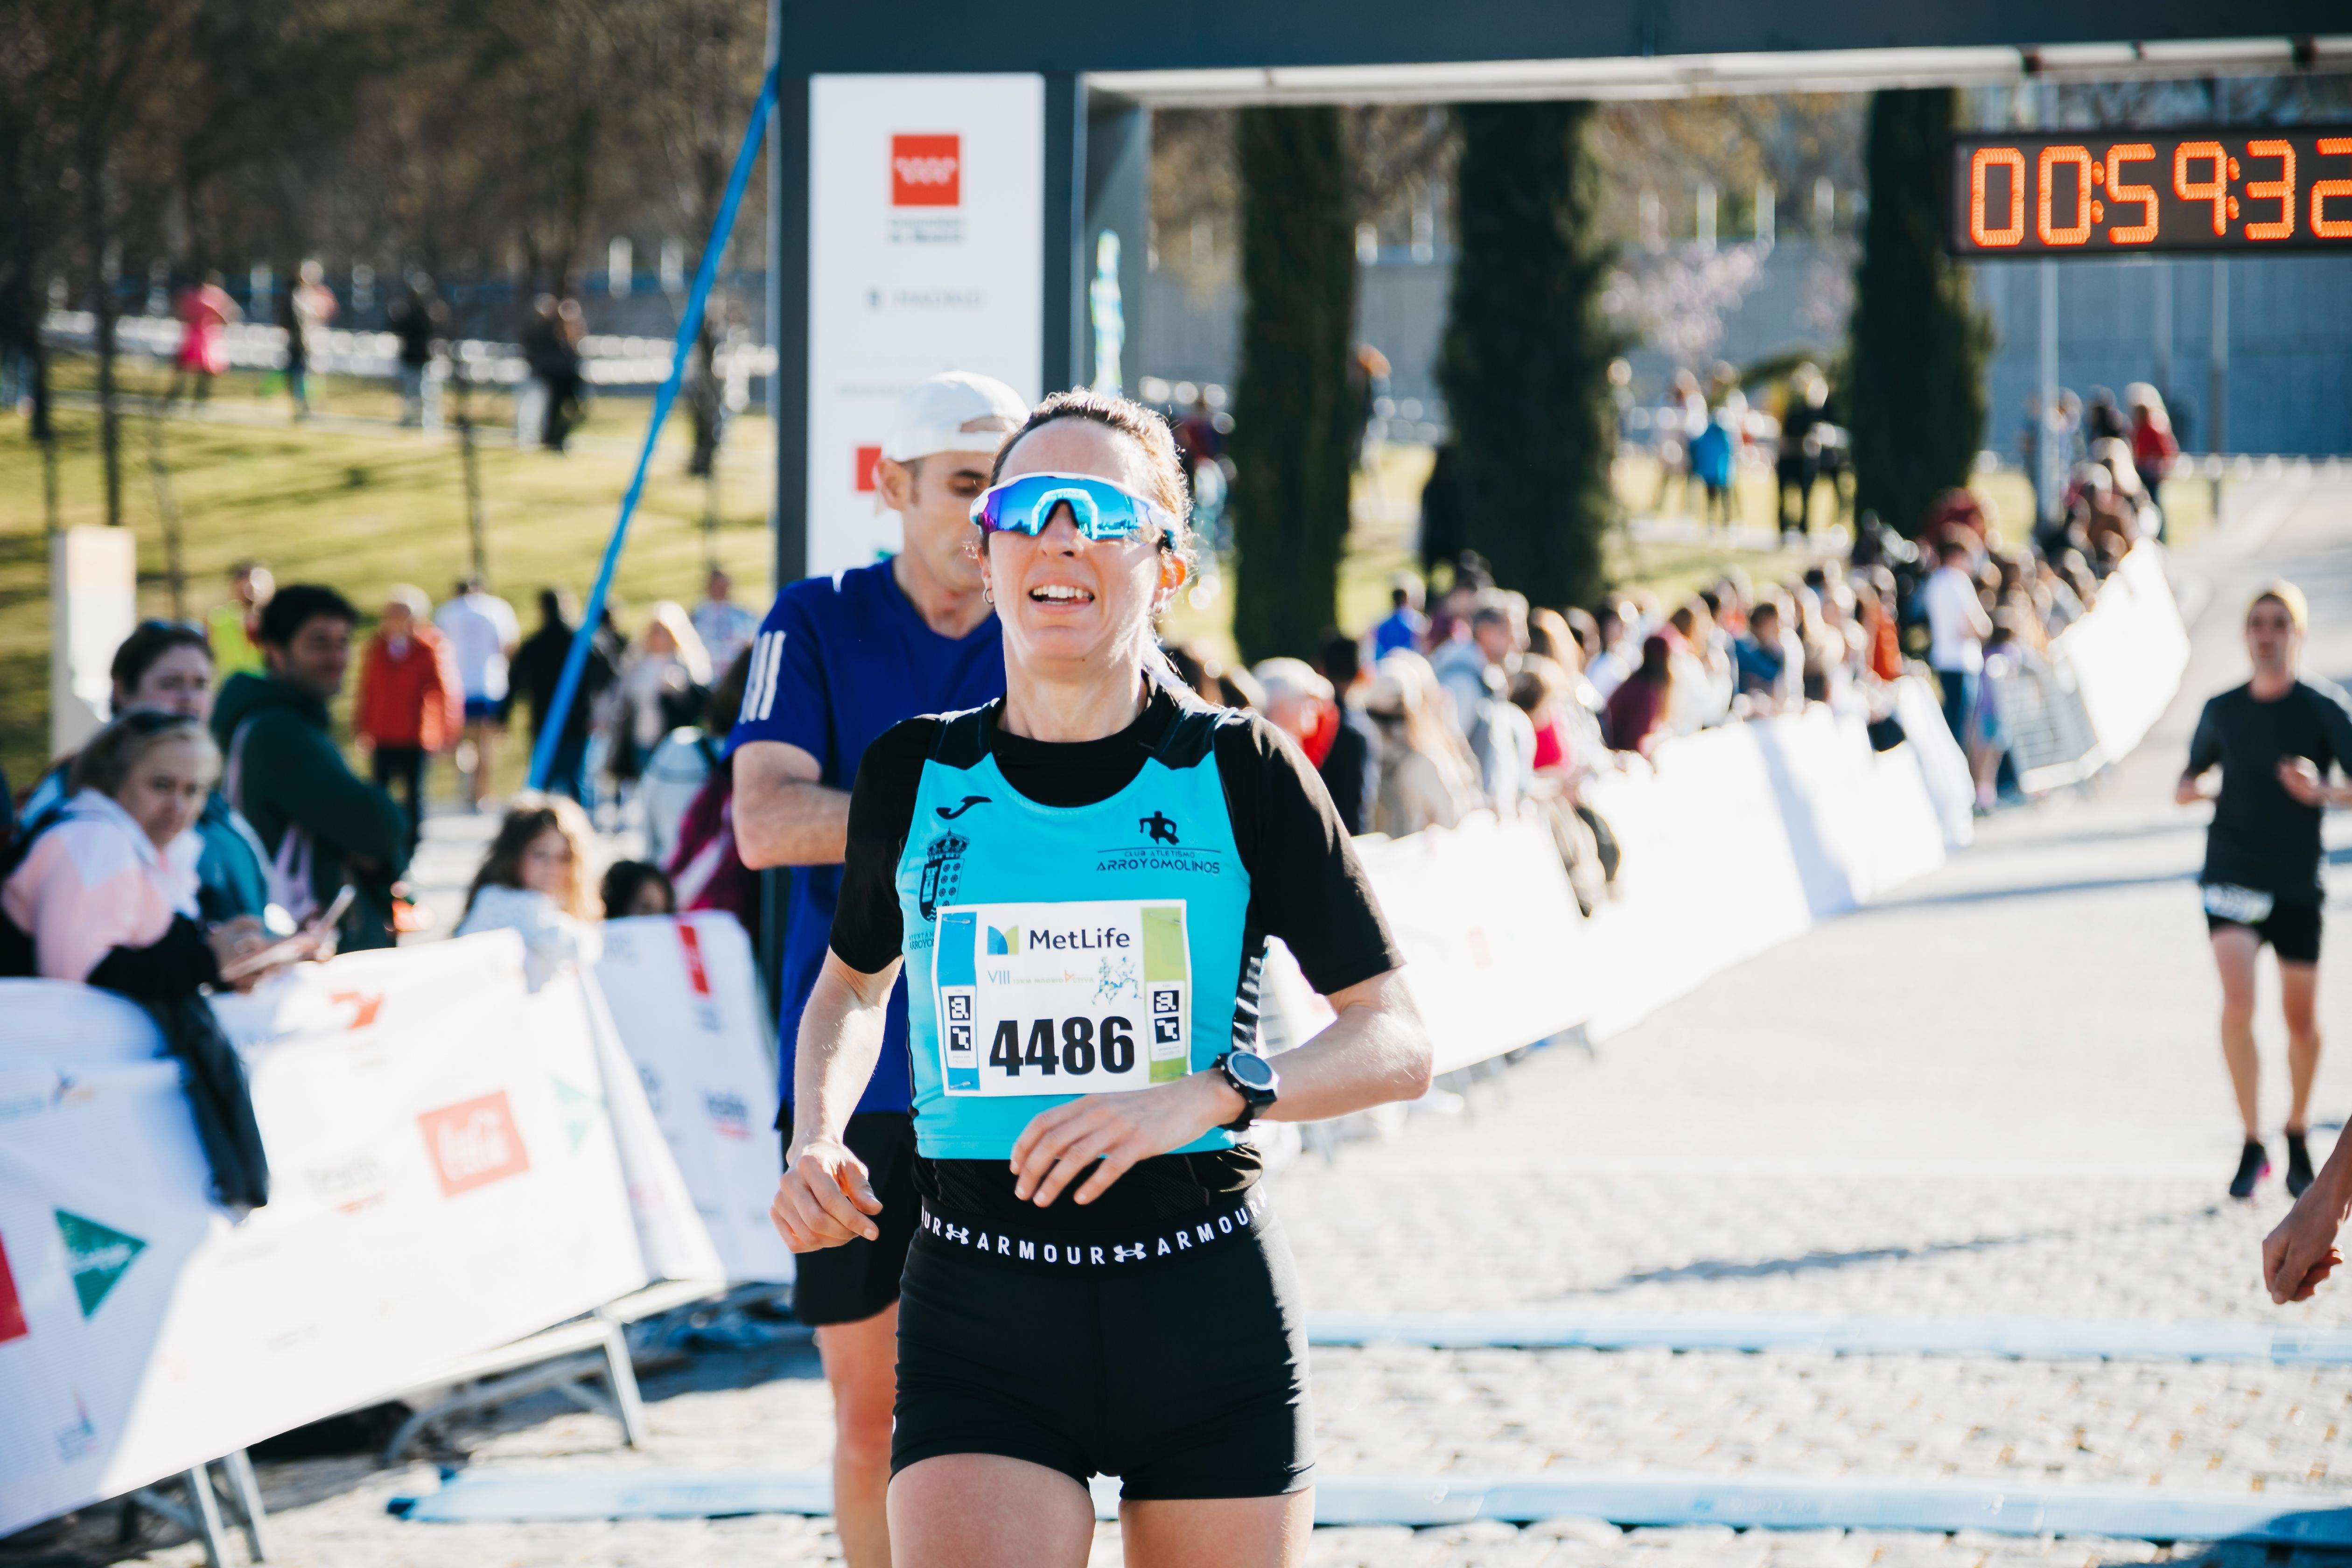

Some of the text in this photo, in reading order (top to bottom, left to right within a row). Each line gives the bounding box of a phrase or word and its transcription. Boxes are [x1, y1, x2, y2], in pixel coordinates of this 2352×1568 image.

[1097, 858, 1220, 874] ARROYOMOLINOS
[1030, 927, 1130, 950] MetLife
[988, 971, 1010, 984] VIII
[989, 1016, 1134, 1076] 4486
[977, 1232, 1105, 1264] ARMOUR
[1158, 1200, 1260, 1256] ARMOUR
